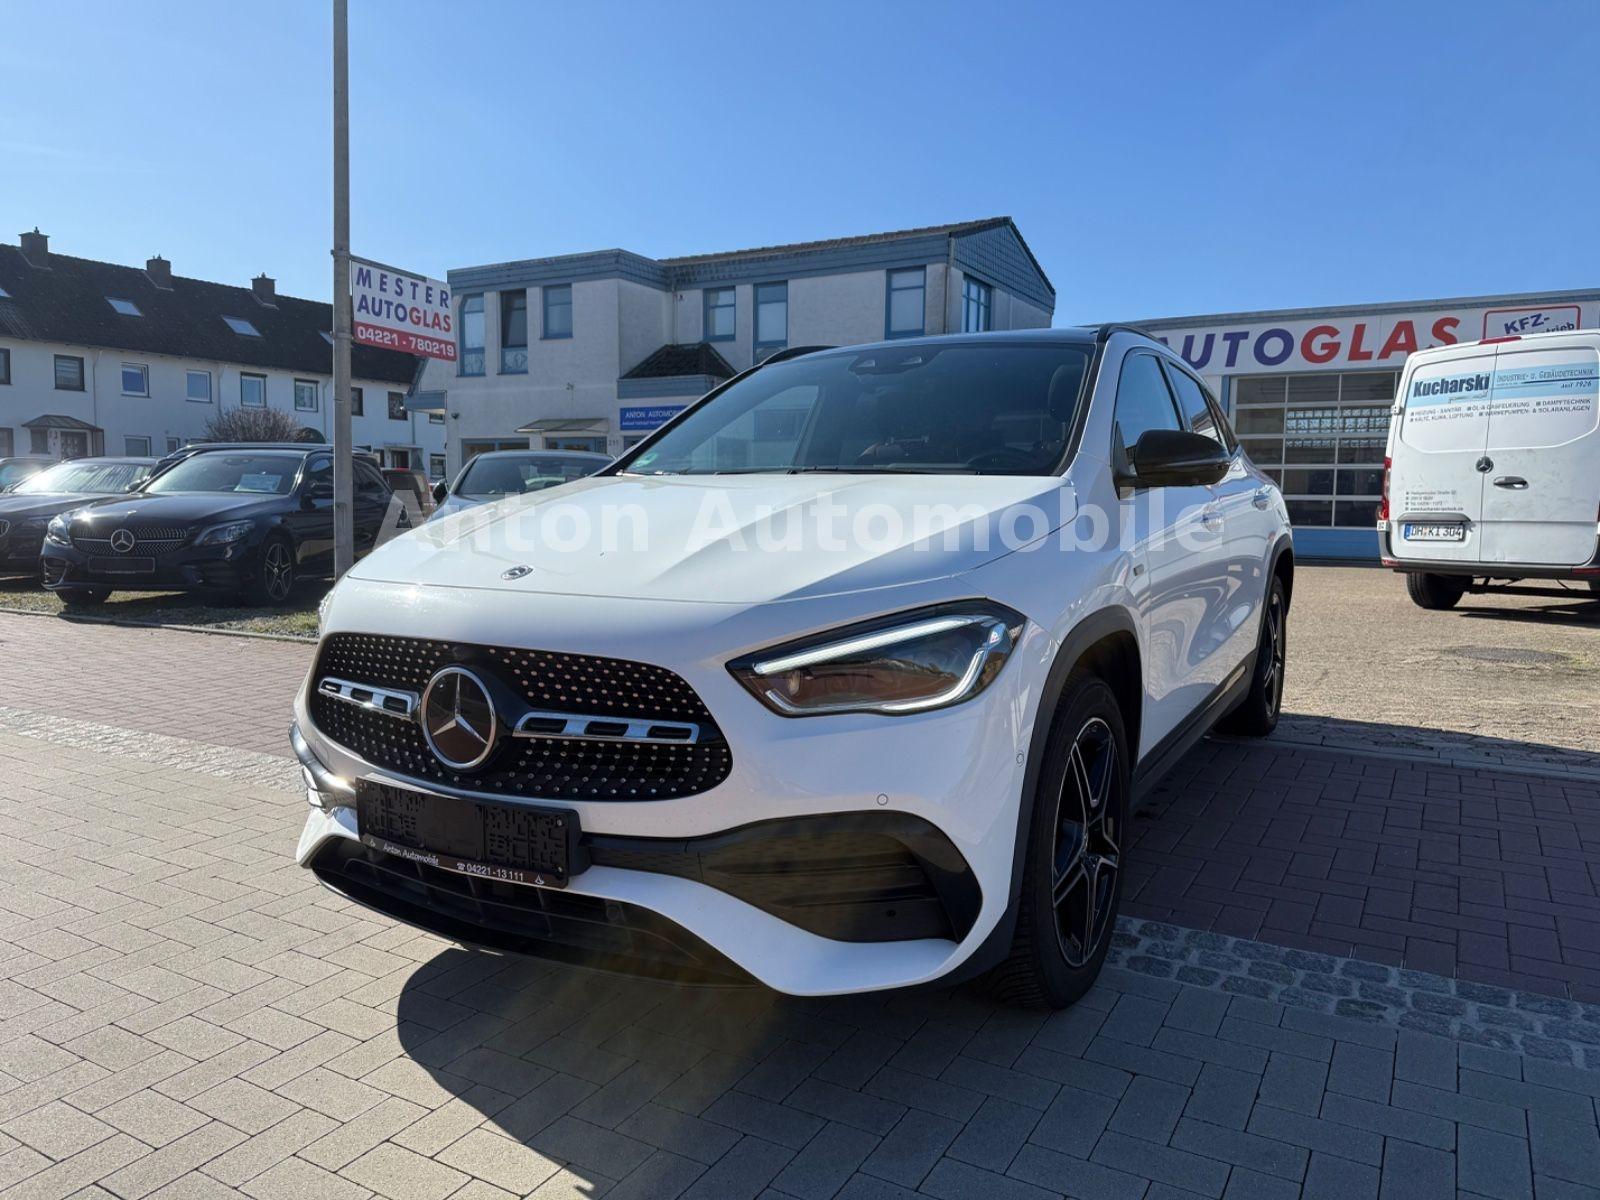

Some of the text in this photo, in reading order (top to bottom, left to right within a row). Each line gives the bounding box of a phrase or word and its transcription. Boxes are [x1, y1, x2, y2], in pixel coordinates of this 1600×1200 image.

[356, 267, 449, 308] MESTER
[357, 294, 452, 333] AUTOGLAS
[1504, 313, 1550, 335] KFZ-
[357, 326, 399, 346] 04221
[409, 337, 454, 356] 780219
[1157, 317, 1461, 370] UTOGLAS
[1413, 373, 1491, 397] Kucharski
[1539, 368, 1594, 379] GEBÄUDETECHNIK
[1575, 379, 1592, 388] 1926
[625, 411, 645, 419] ANTON
